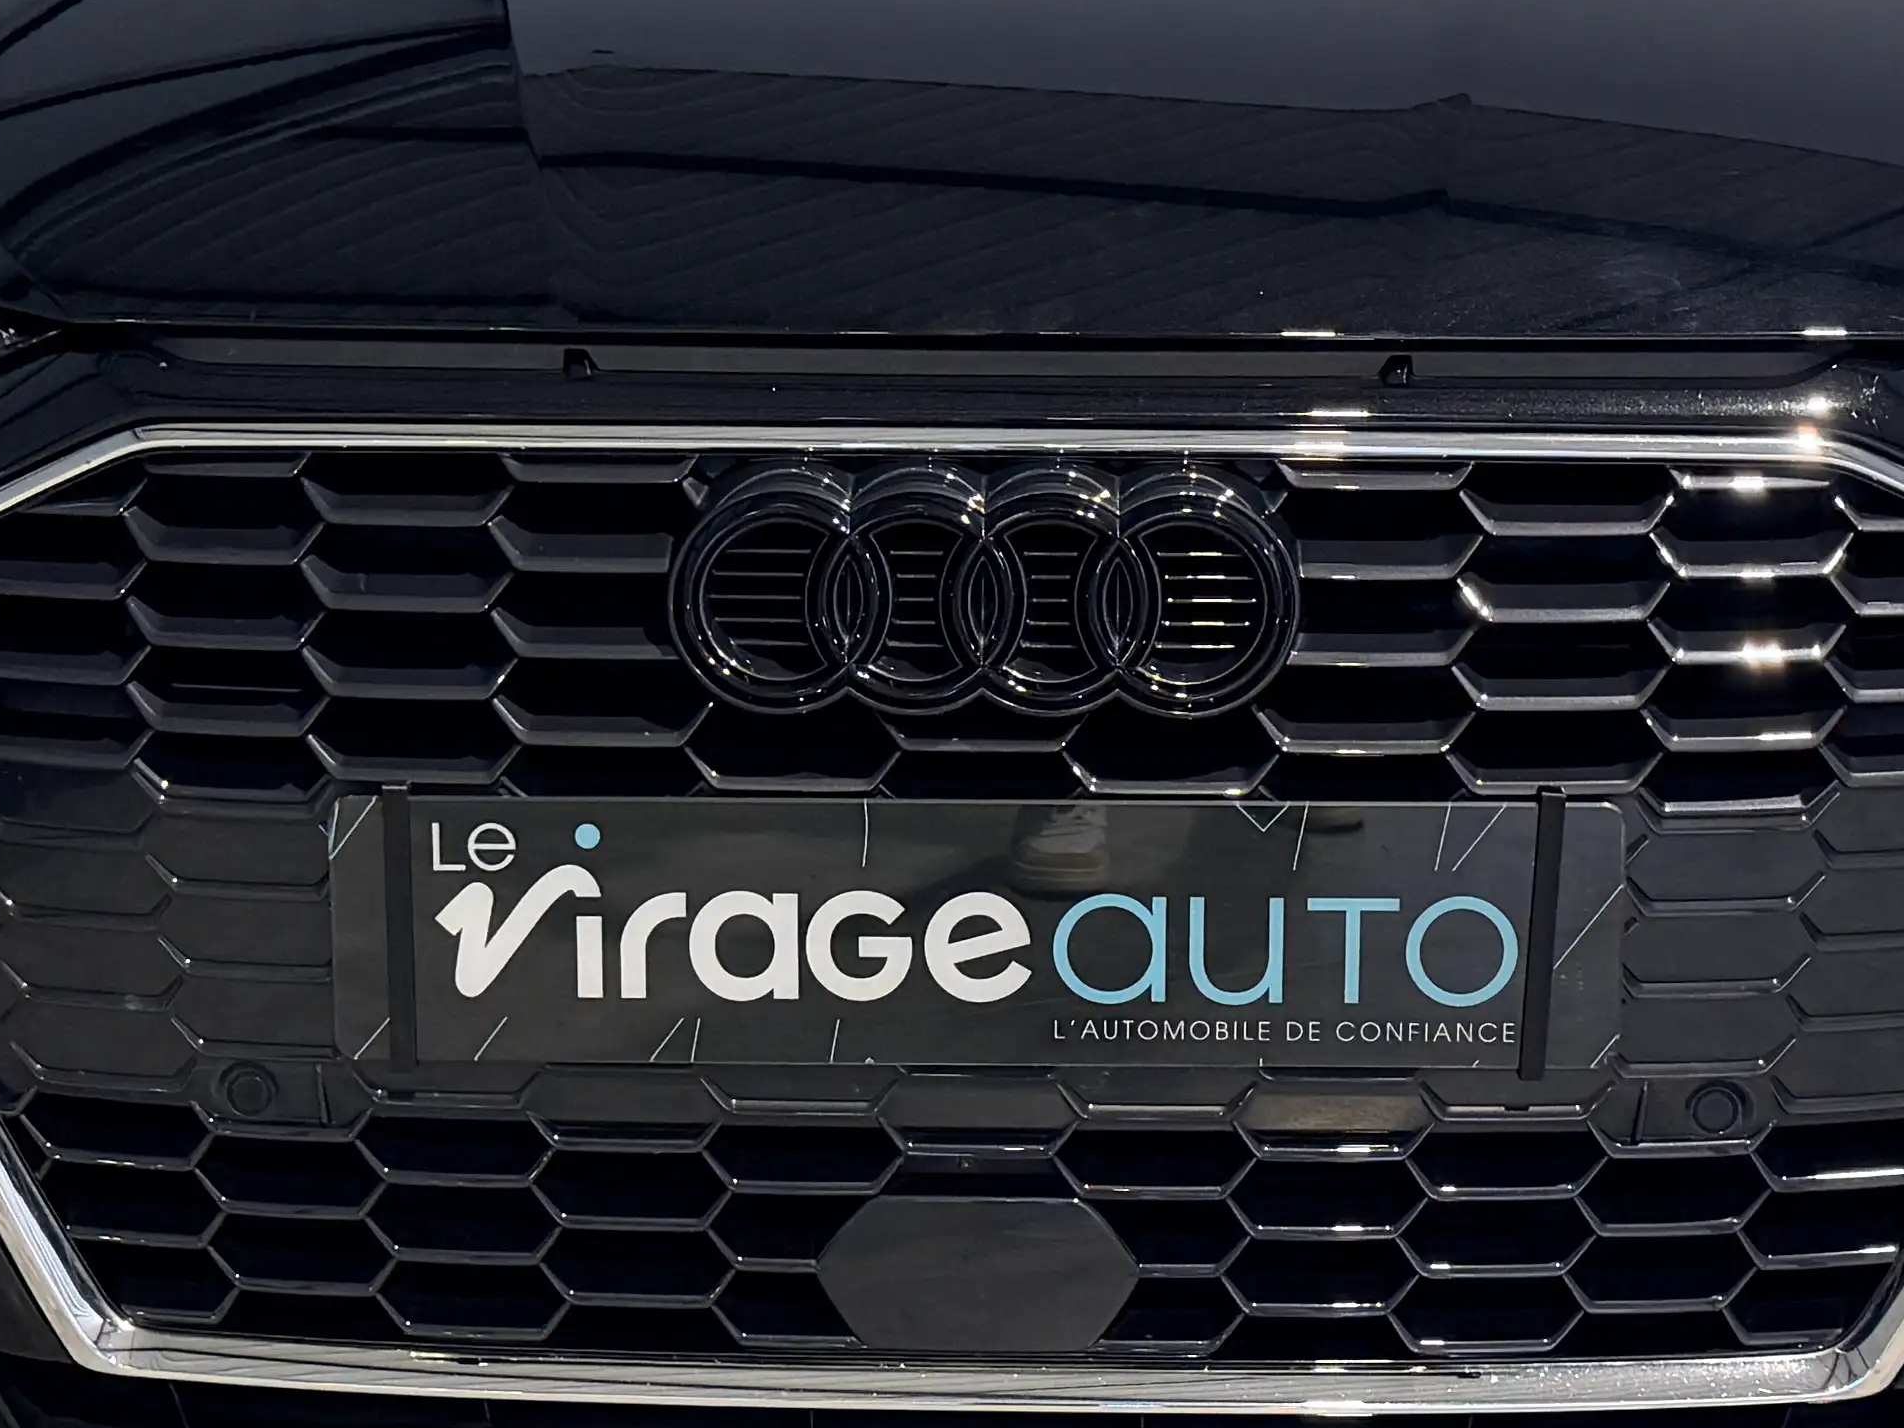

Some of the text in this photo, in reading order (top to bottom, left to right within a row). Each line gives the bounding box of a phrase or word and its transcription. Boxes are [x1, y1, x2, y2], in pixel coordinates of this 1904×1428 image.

[1053, 1019, 1516, 1043] L'AUTOMOBILE DE CONFIANCE
